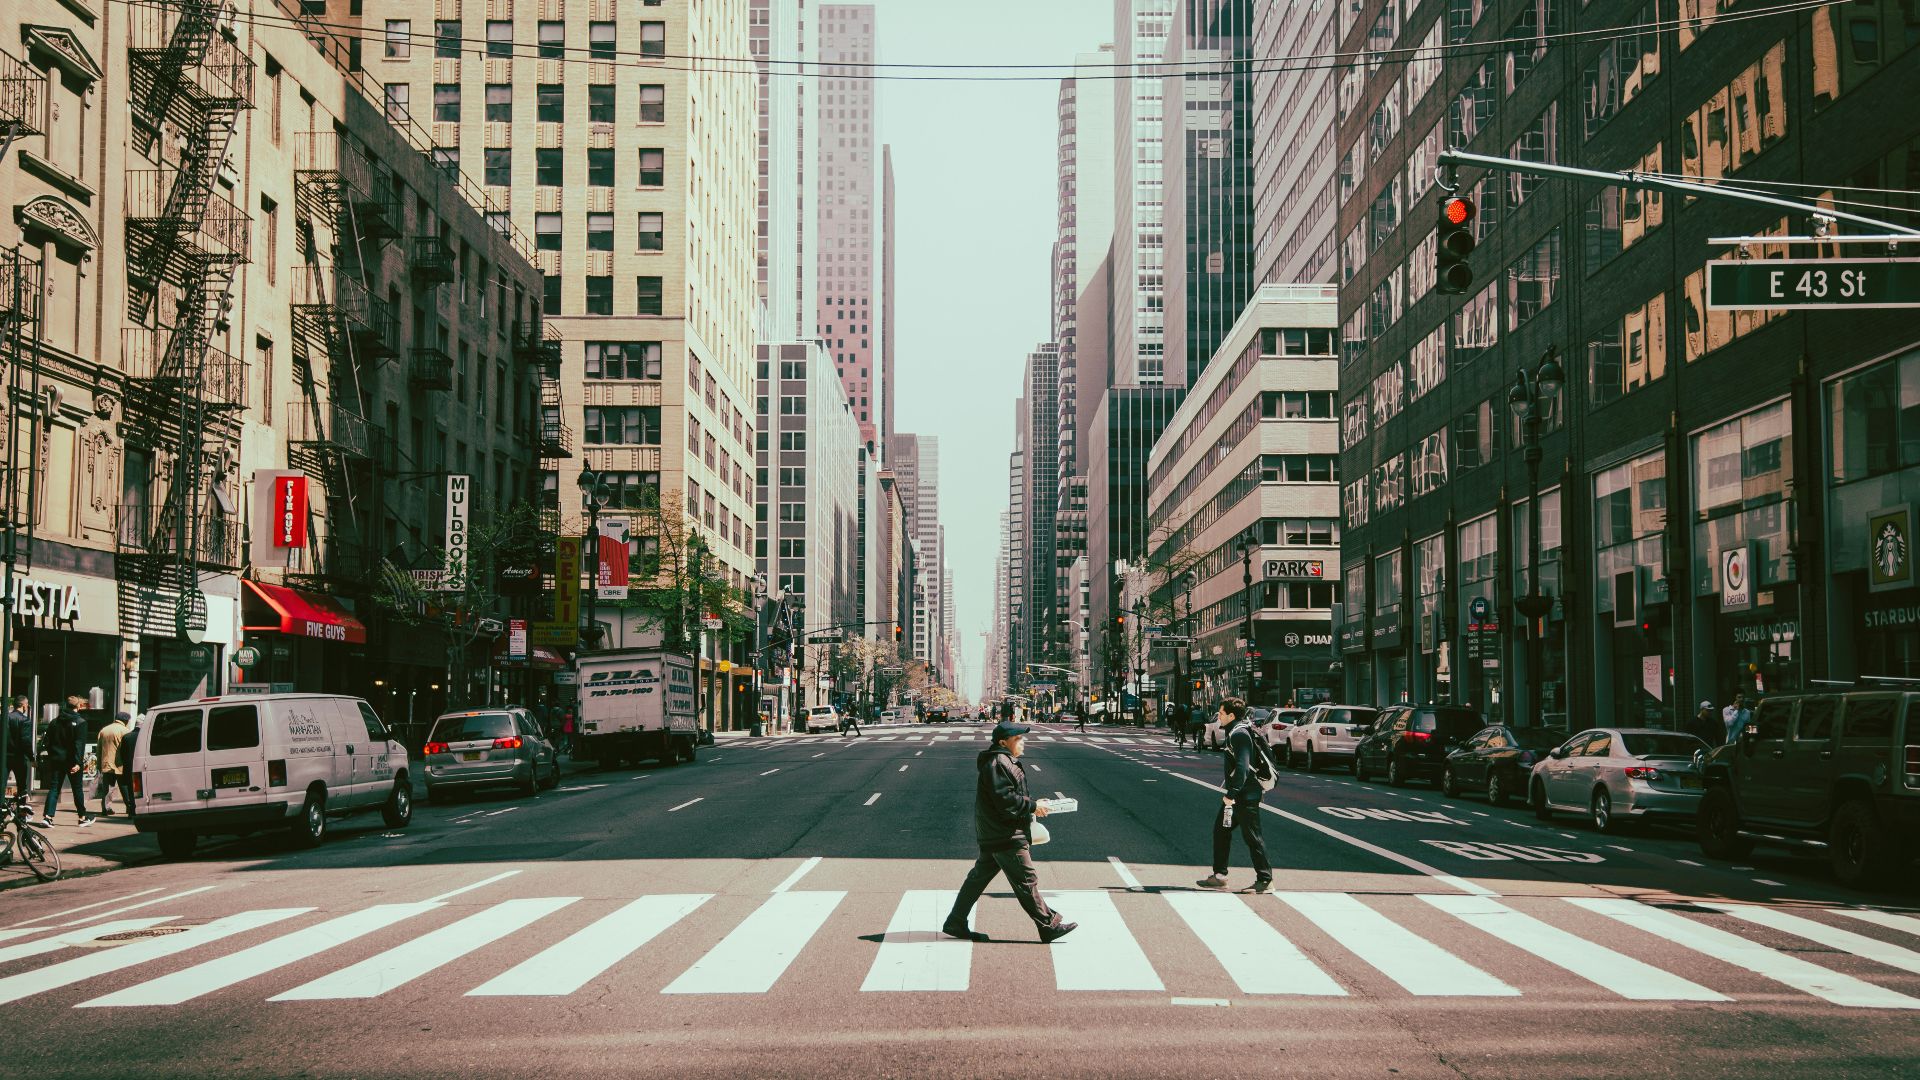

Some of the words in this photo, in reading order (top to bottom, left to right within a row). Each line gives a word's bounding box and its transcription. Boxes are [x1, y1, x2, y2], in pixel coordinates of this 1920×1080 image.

[1770, 270, 1785, 298] E
[1795, 270, 1829, 298] 43
[1839, 269, 1867, 297] St
[285, 480, 294, 511] FIVE
[284, 512, 294, 543] GUYS
[414, 570, 444, 581] IRISH
[1268, 561, 1309, 576] PARK
[559, 541, 577, 623] DELI
[1726, 592, 1747, 606] bento
[306, 621, 324, 638] FIVE
[325, 623, 346, 641] GUYS
[1733, 626, 1759, 643] SUSHI
[1760, 624, 1767, 640] &
[1317, 806, 1472, 826] ONLY
[1418, 839, 1607, 864] BUS
